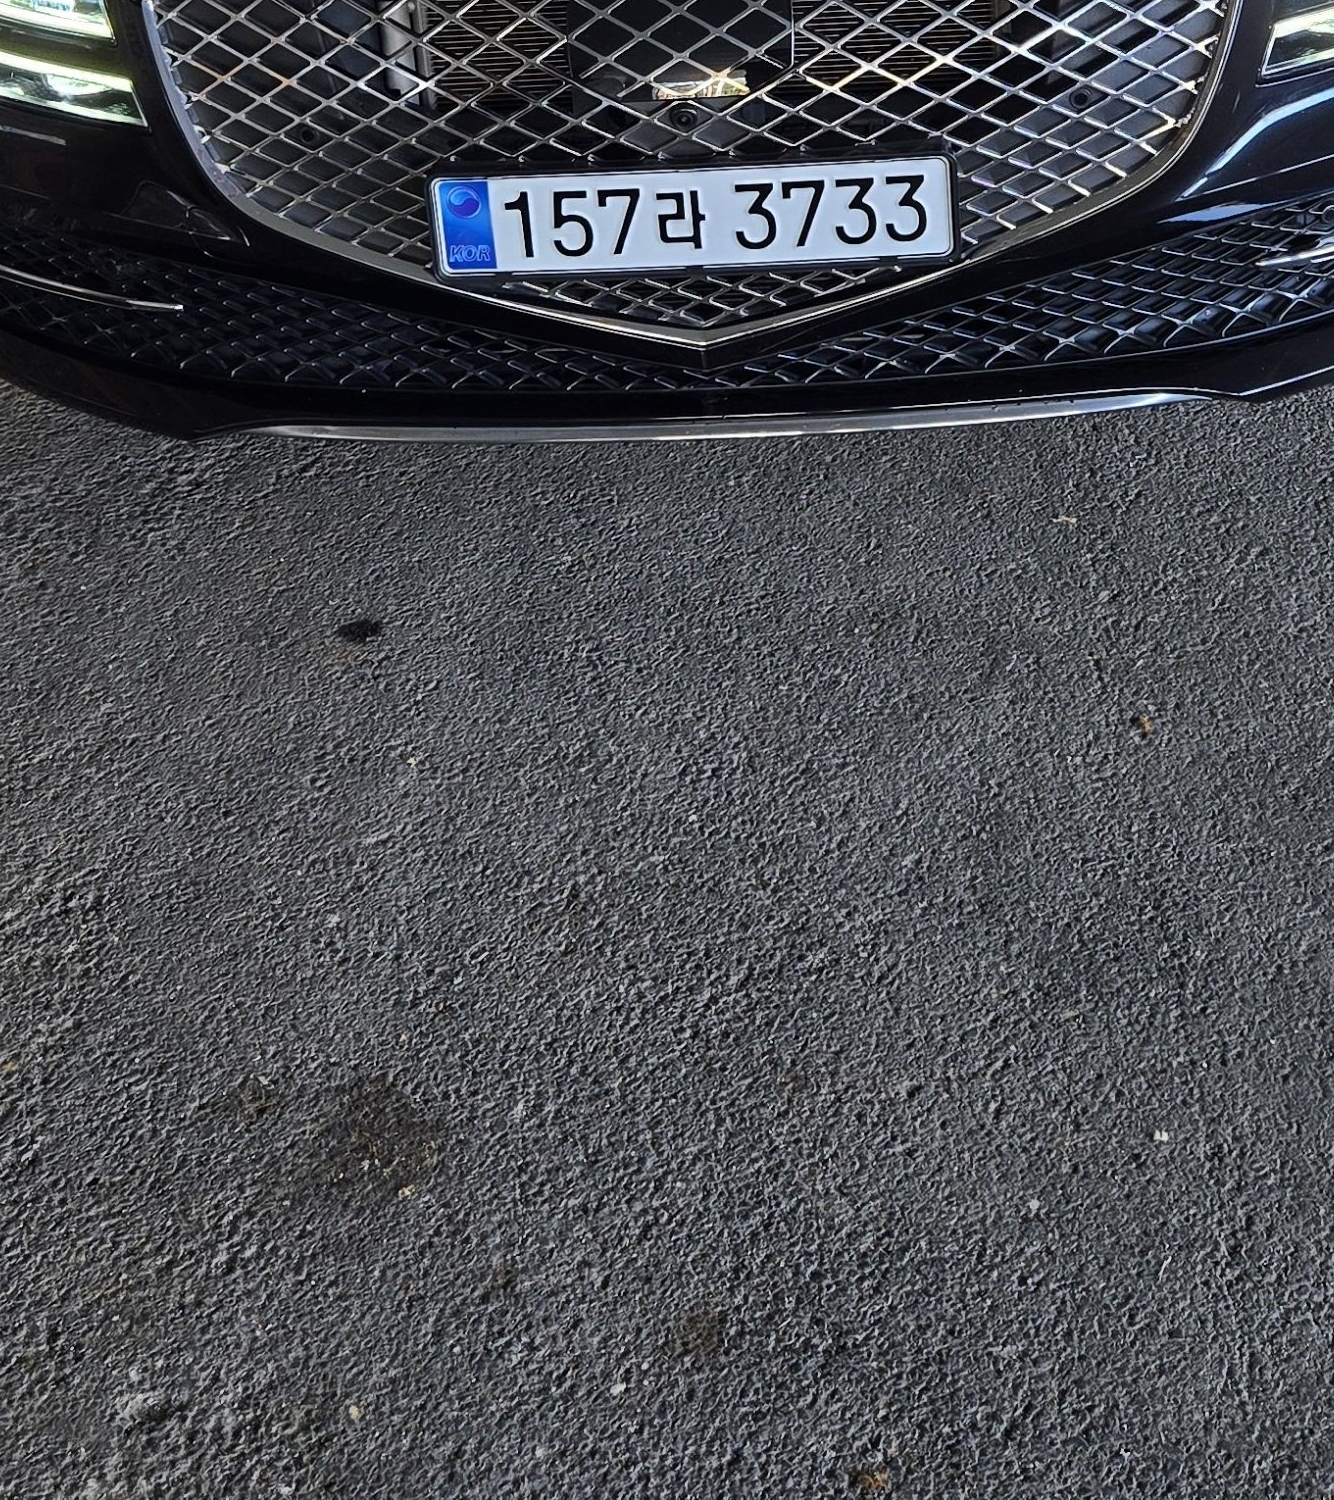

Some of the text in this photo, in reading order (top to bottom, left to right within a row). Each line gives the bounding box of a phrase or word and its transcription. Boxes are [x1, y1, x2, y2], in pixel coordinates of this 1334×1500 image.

[504, 174, 927, 258] 157라 3733
[449, 244, 491, 262] KOR
